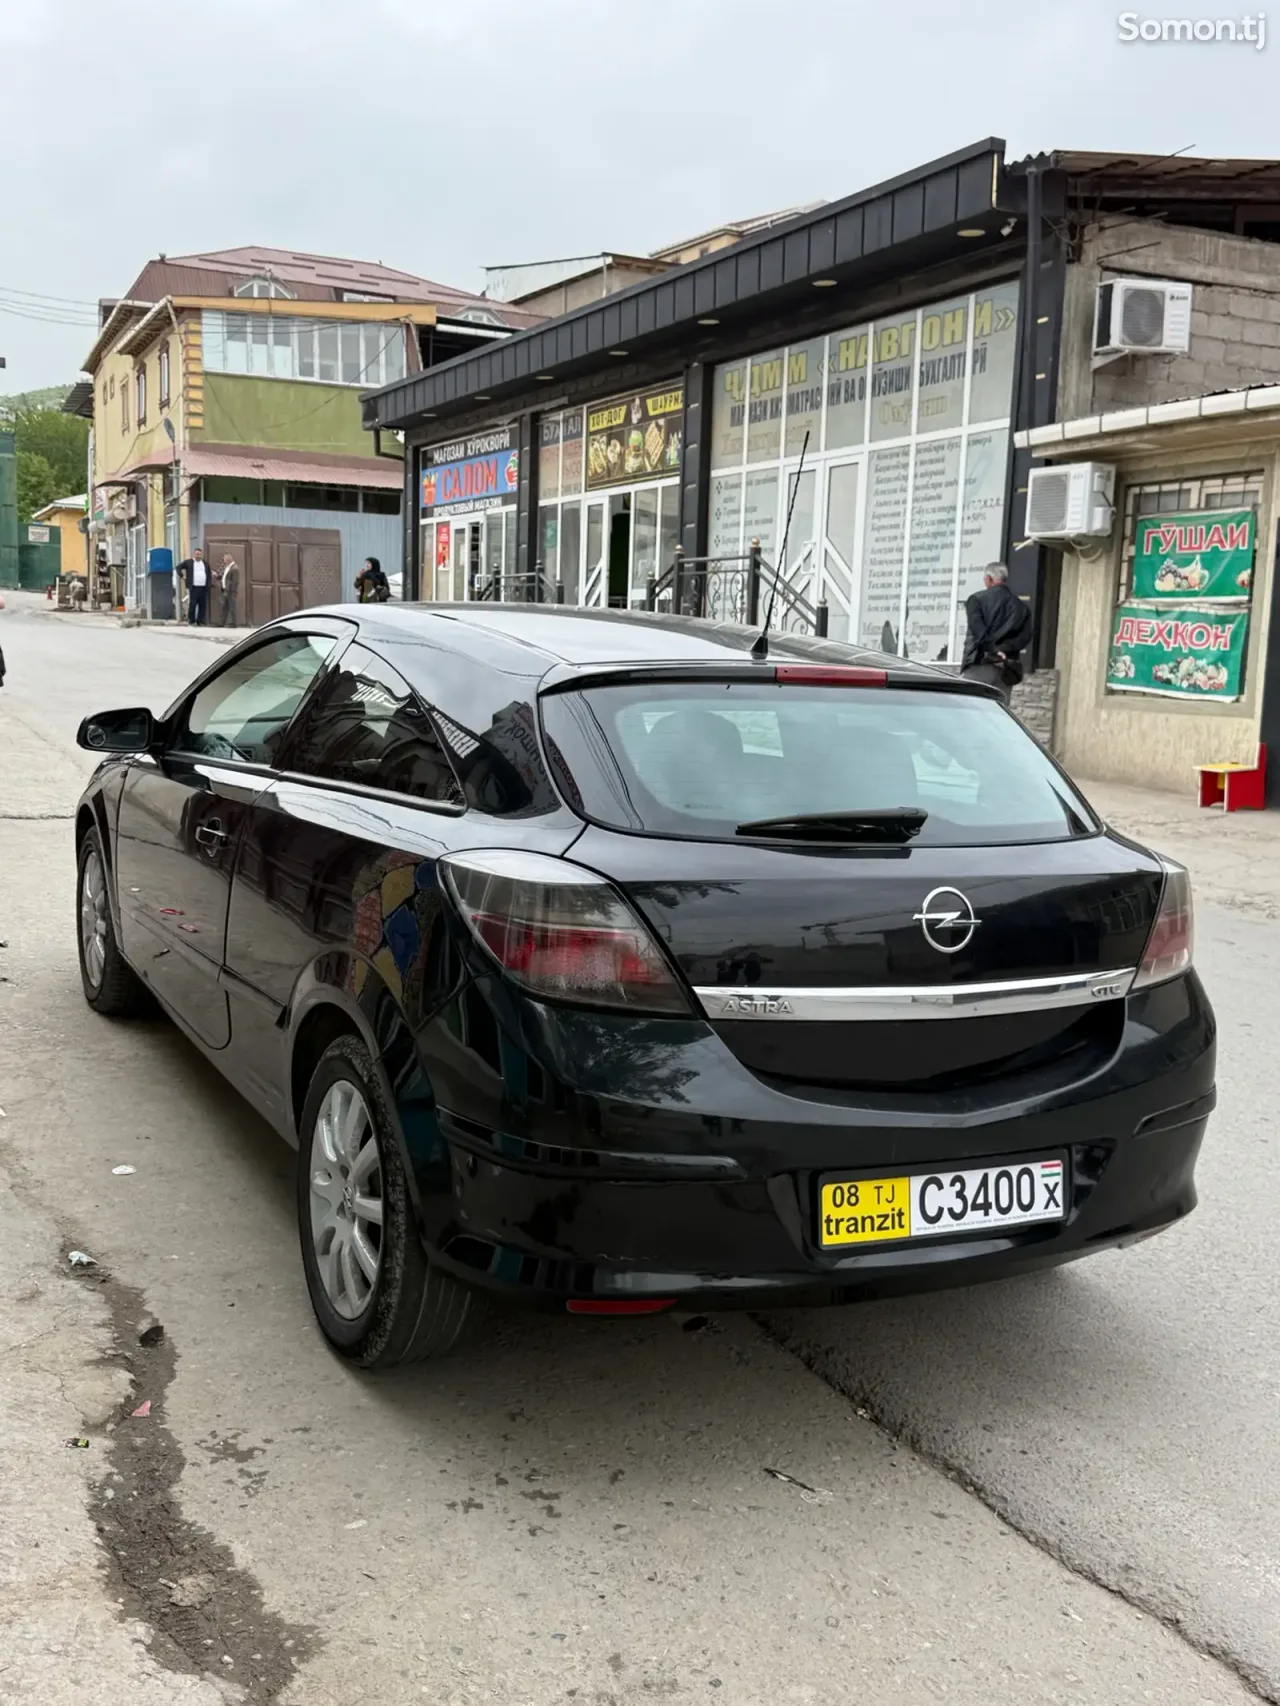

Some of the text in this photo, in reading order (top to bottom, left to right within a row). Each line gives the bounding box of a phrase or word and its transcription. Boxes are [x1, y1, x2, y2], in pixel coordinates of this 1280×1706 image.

[441, 458, 498, 502] САЛОМ
[721, 1000, 795, 1014] ASTRA
[832, 1184, 895, 1208] 08 TJ
[919, 1167, 1036, 1225] C3400
[824, 1207, 906, 1236] tranzit
